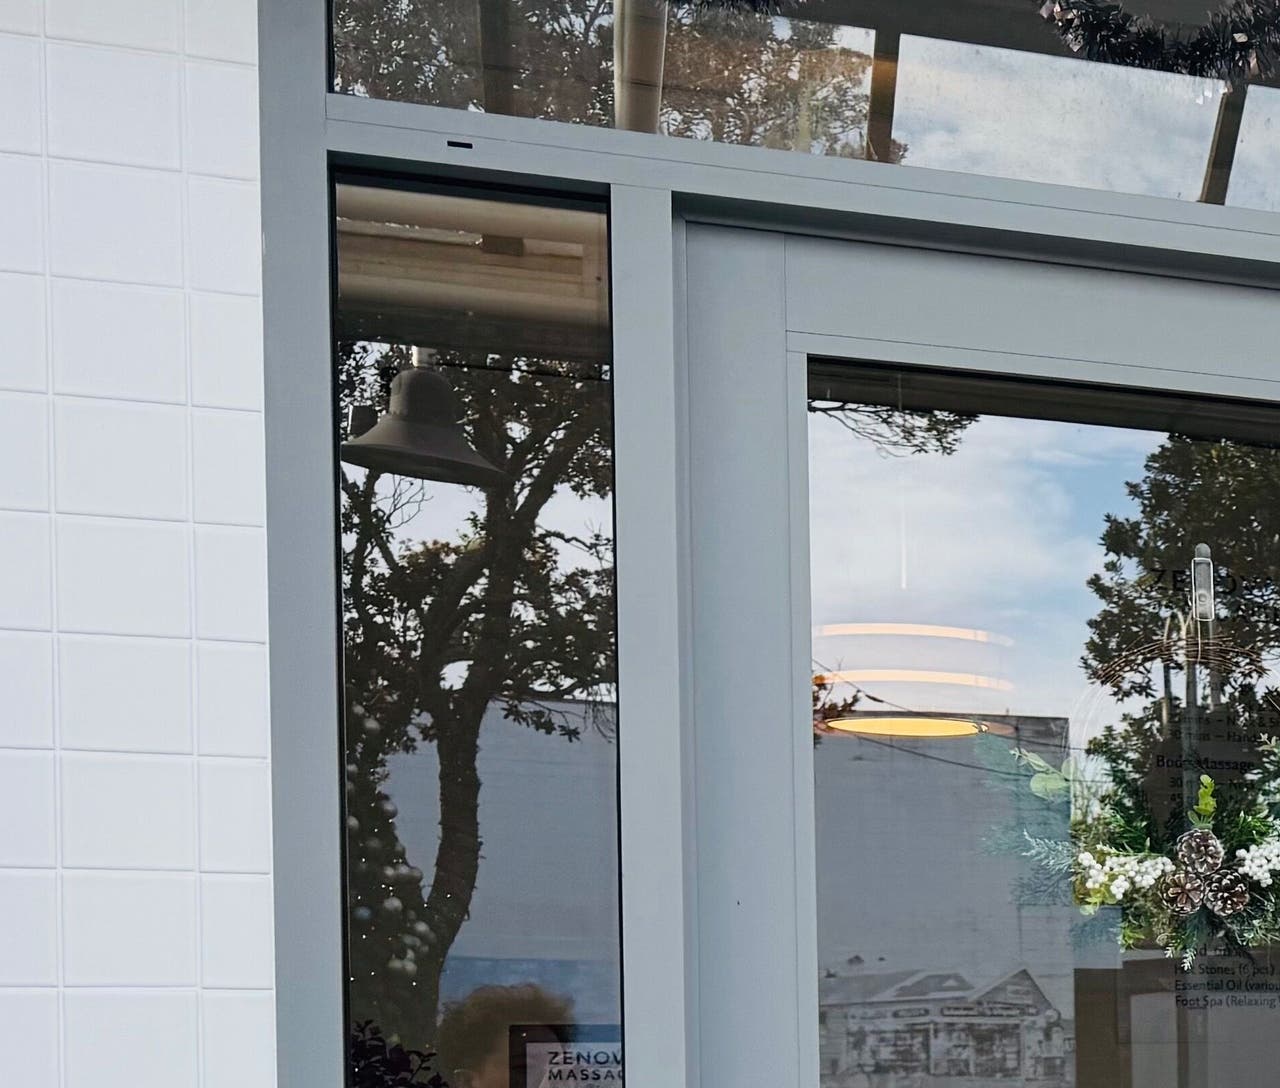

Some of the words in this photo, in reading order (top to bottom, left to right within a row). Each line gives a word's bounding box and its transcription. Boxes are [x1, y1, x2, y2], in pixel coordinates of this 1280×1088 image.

[1174, 979, 1224, 992] Essential
[1226, 979, 1242, 992] Oil
[1174, 995, 1200, 1008] Foot
[1202, 995, 1223, 1010] Spa
